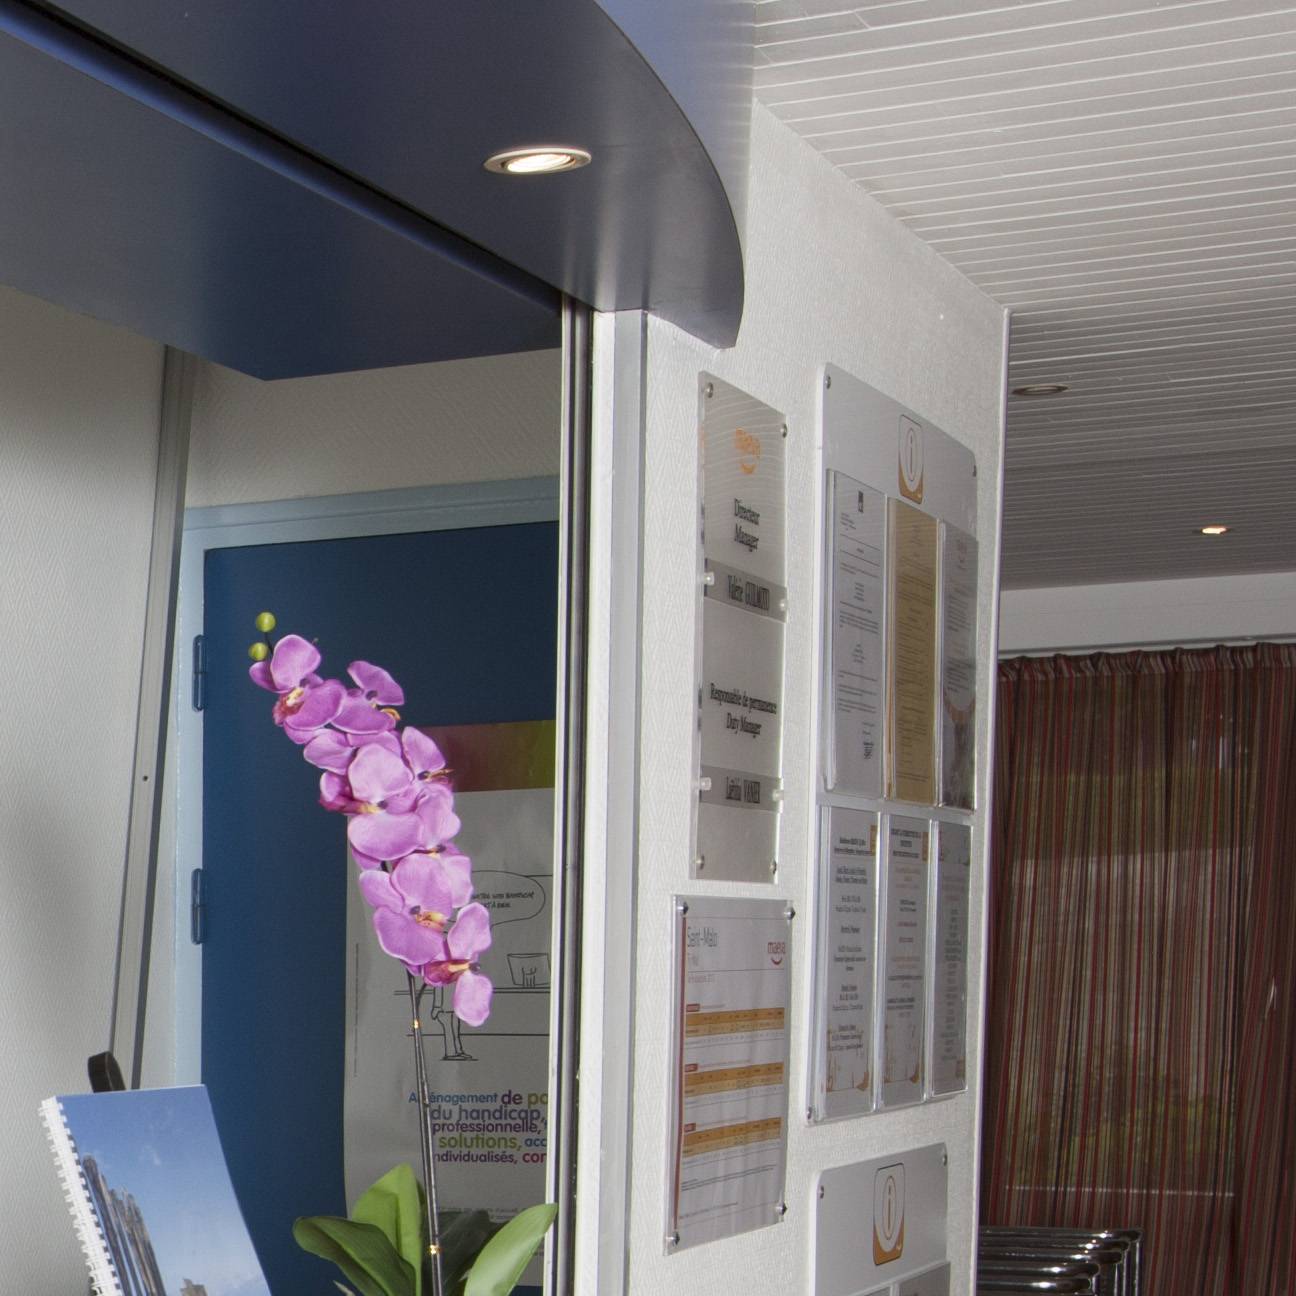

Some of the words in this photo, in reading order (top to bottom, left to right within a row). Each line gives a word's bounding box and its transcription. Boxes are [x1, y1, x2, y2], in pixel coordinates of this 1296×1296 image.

[687, 926, 717, 947] Saint-Malo
[408, 1092, 498, 1105] Aénagement
[501, 1089, 522, 1105] de
[431, 1105, 452, 1120] du
[459, 1104, 545, 1125] handicap,
[433, 1120, 541, 1135] professionnelle,
[439, 1133, 522, 1151] solutions,
[433, 1150, 518, 1164] ndividualisés,
